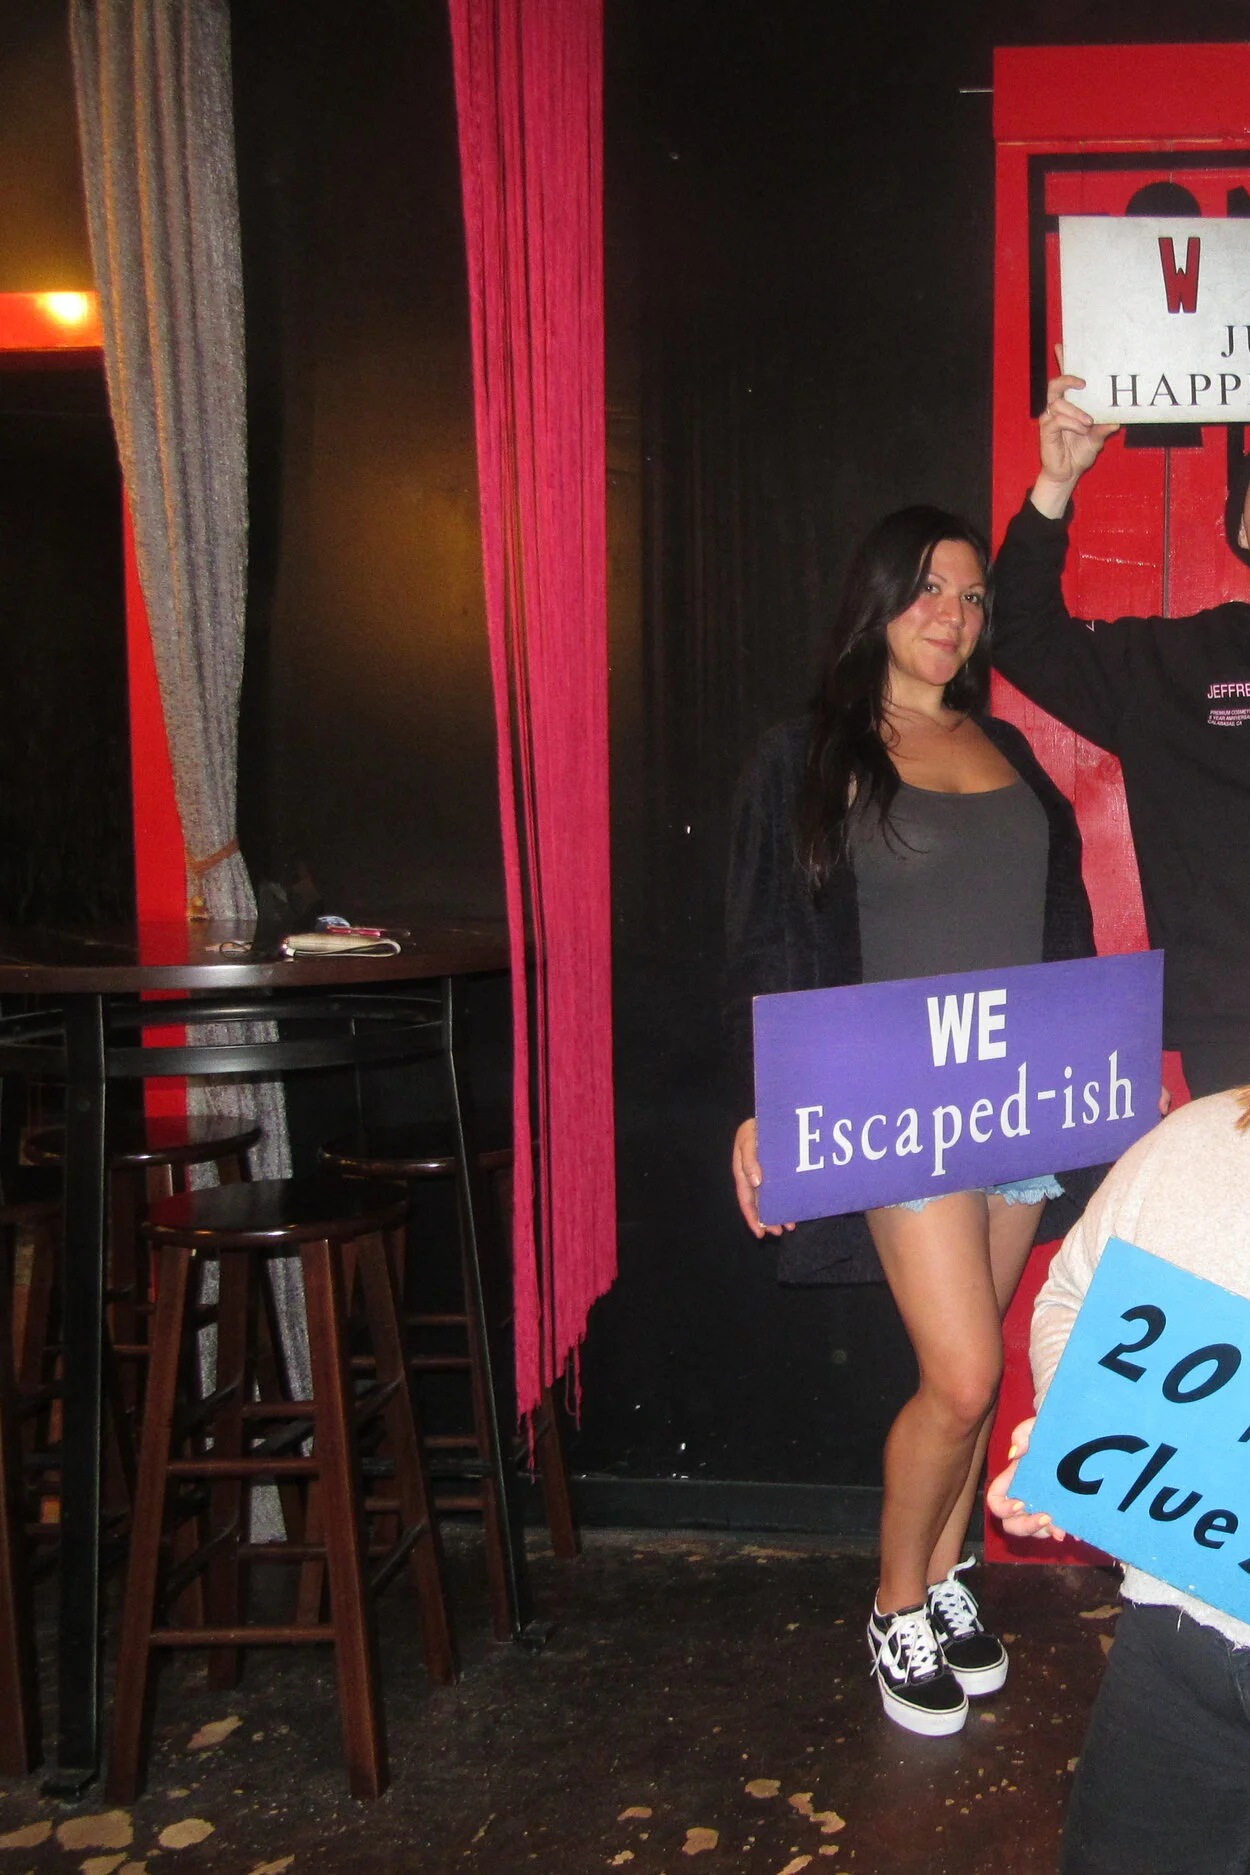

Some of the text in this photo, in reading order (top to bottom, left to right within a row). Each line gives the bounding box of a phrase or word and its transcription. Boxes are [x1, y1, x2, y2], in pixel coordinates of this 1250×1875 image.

[927, 989, 1008, 1067] WE
[795, 1050, 1135, 1177] Escaped-ish
[1097, 1304, 1242, 1404] 20
